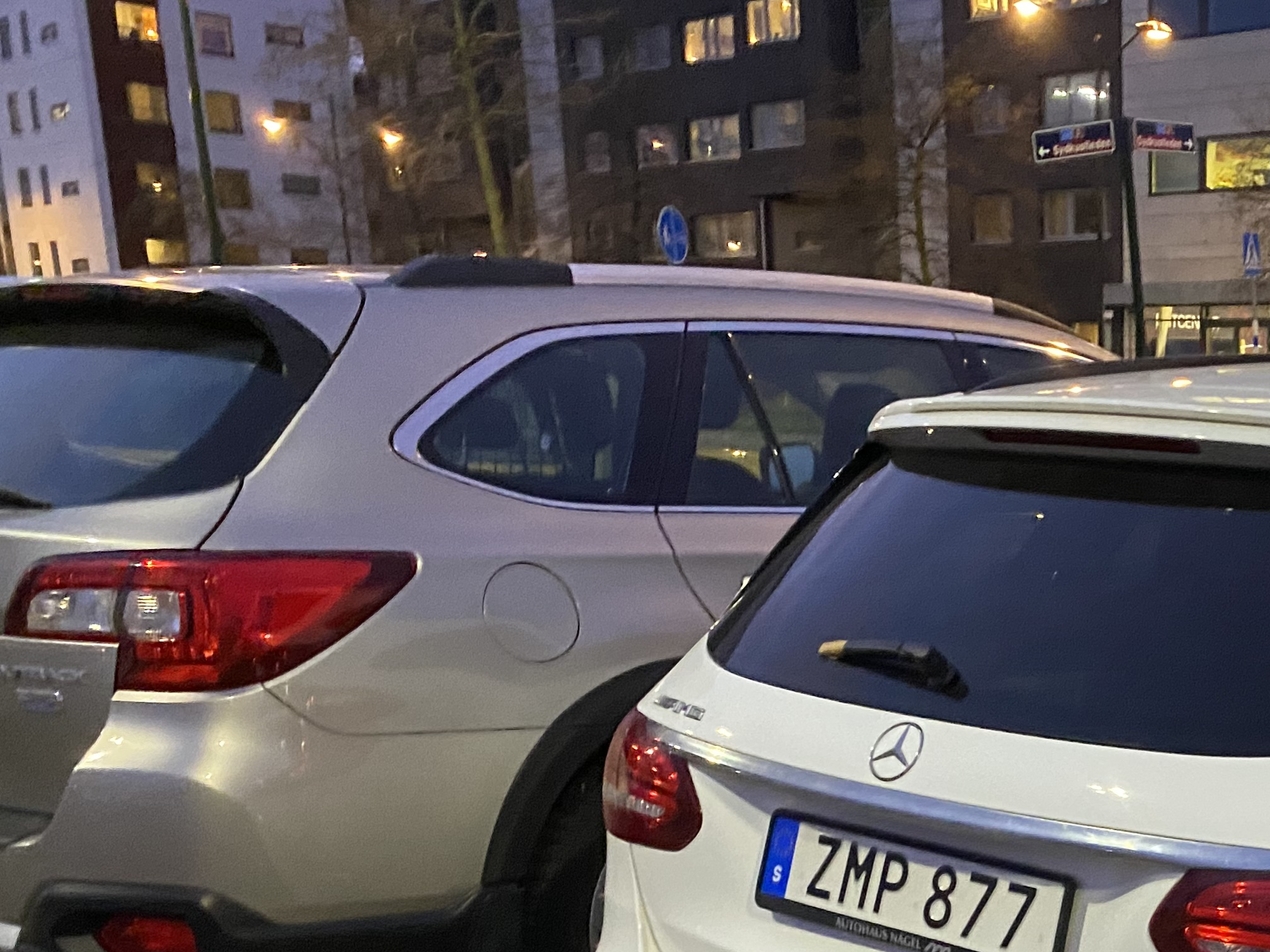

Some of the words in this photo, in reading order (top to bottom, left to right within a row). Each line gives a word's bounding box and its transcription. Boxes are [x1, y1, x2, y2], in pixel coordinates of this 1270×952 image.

[771, 864, 782, 883] S
[806, 833, 909, 914] ZMP
[923, 864, 1038, 949] 877
[835, 916, 888, 941] AUTOHAUS
